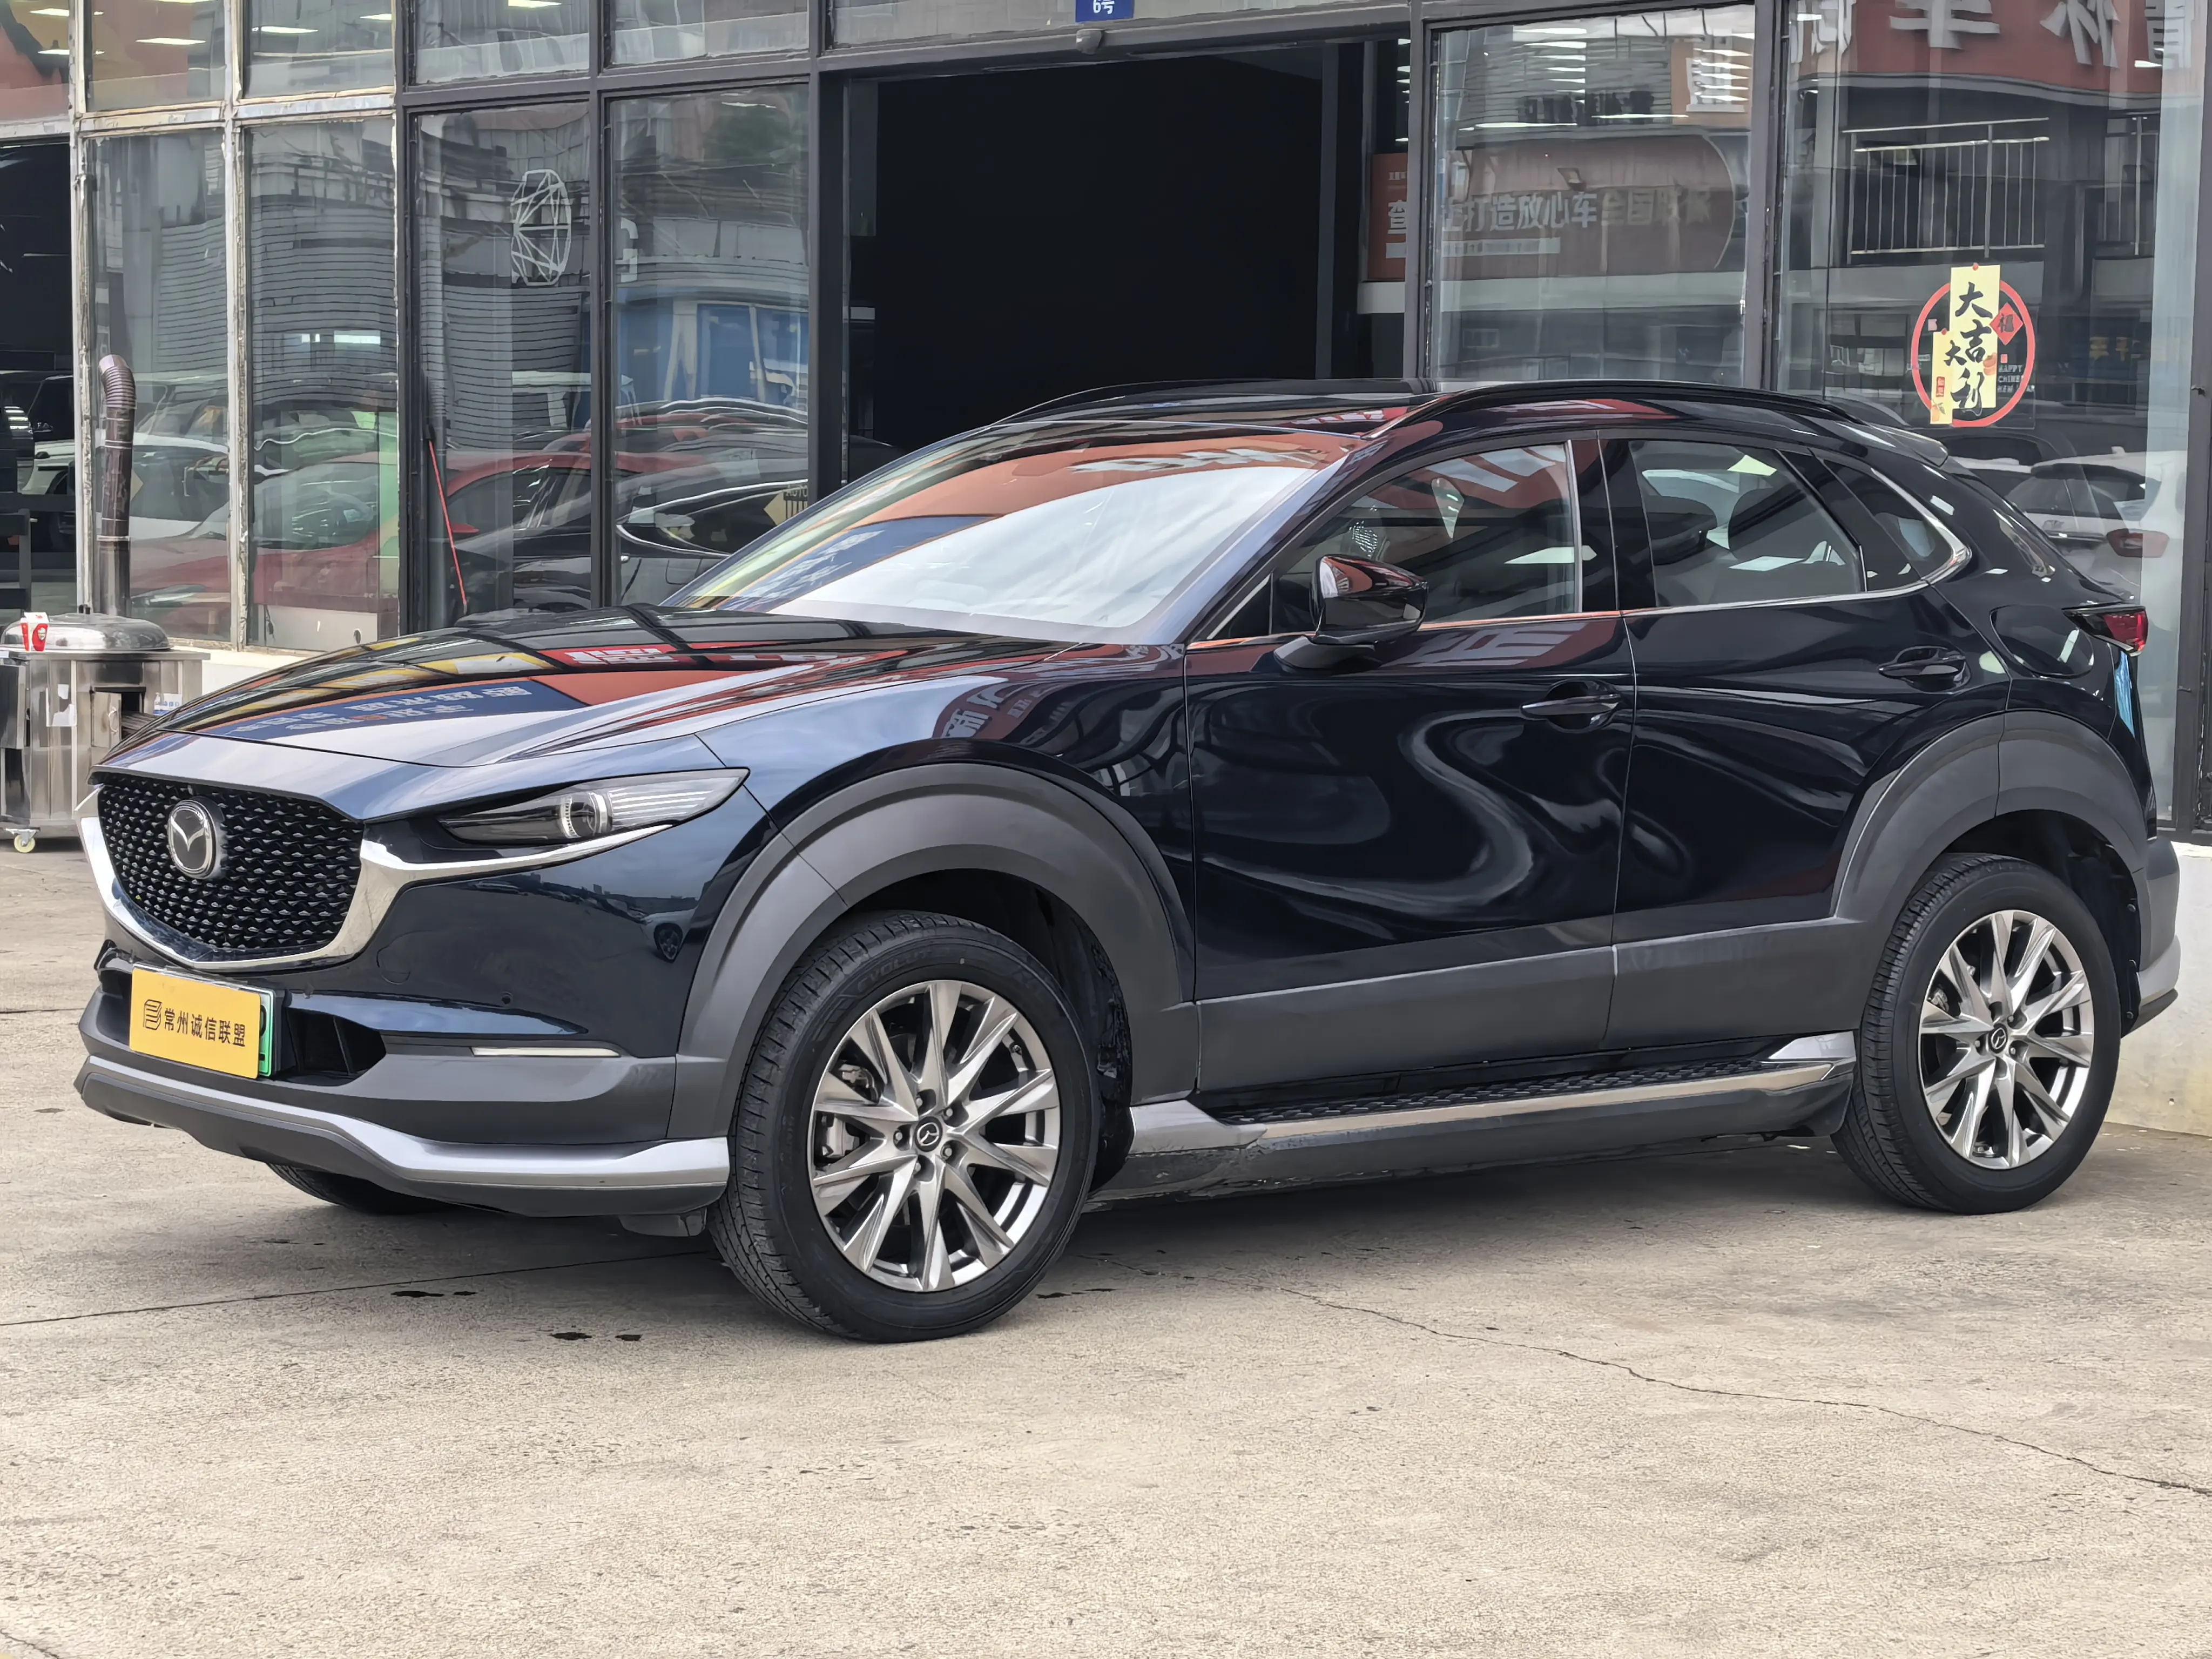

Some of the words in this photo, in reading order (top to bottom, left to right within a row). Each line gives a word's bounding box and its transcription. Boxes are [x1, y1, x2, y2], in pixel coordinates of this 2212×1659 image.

[164, 1008, 246, 1047] 常州诚信联盟
